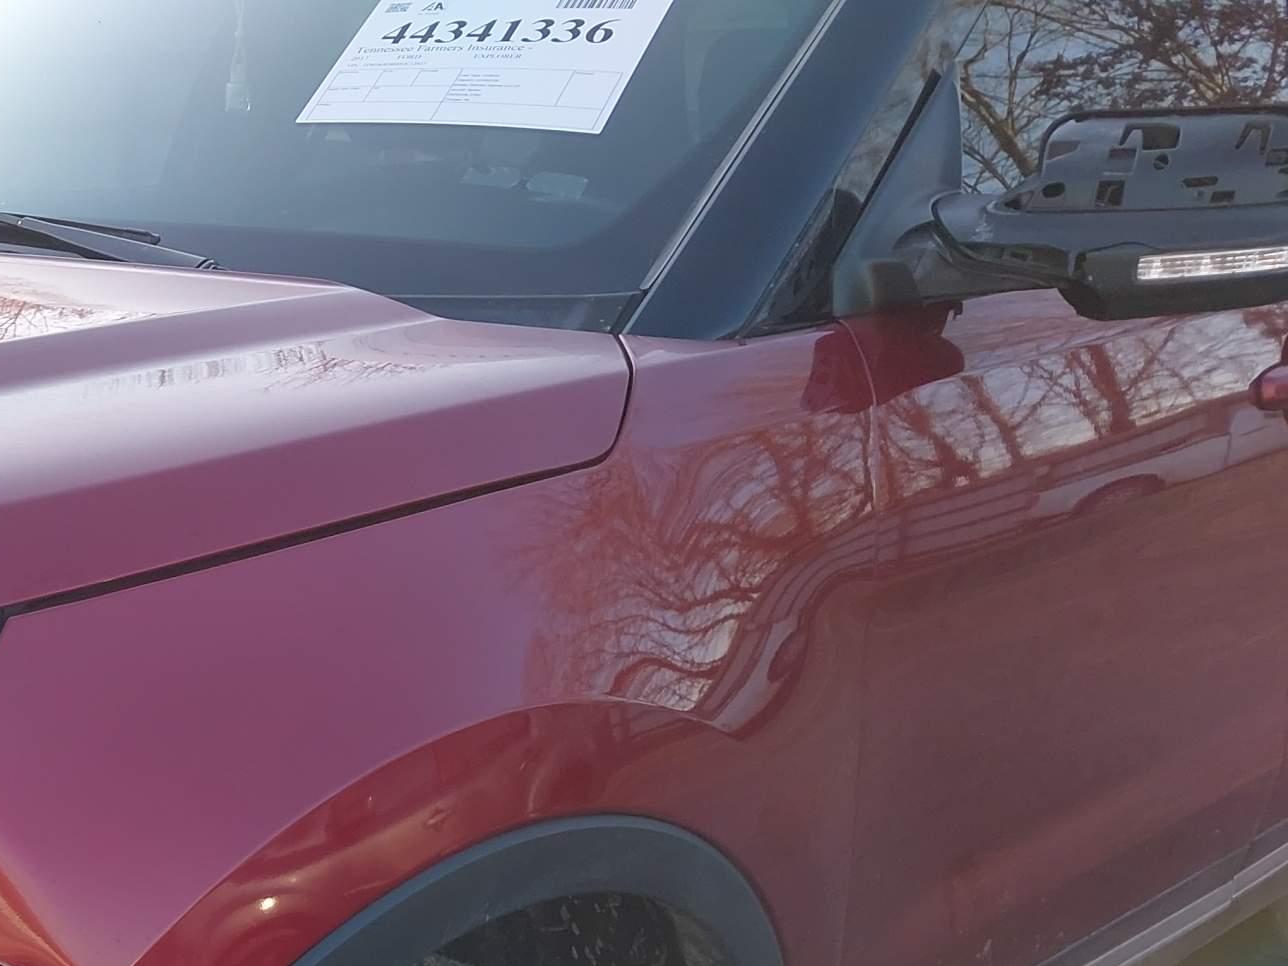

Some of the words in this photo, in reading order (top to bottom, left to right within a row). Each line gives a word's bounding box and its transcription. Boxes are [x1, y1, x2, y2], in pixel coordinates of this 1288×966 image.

[381, 18, 620, 44] 44341336
[357, 46, 413, 54] Tennessee
[416, 44, 463, 52] Farmers
[467, 43, 525, 52] Insurance
